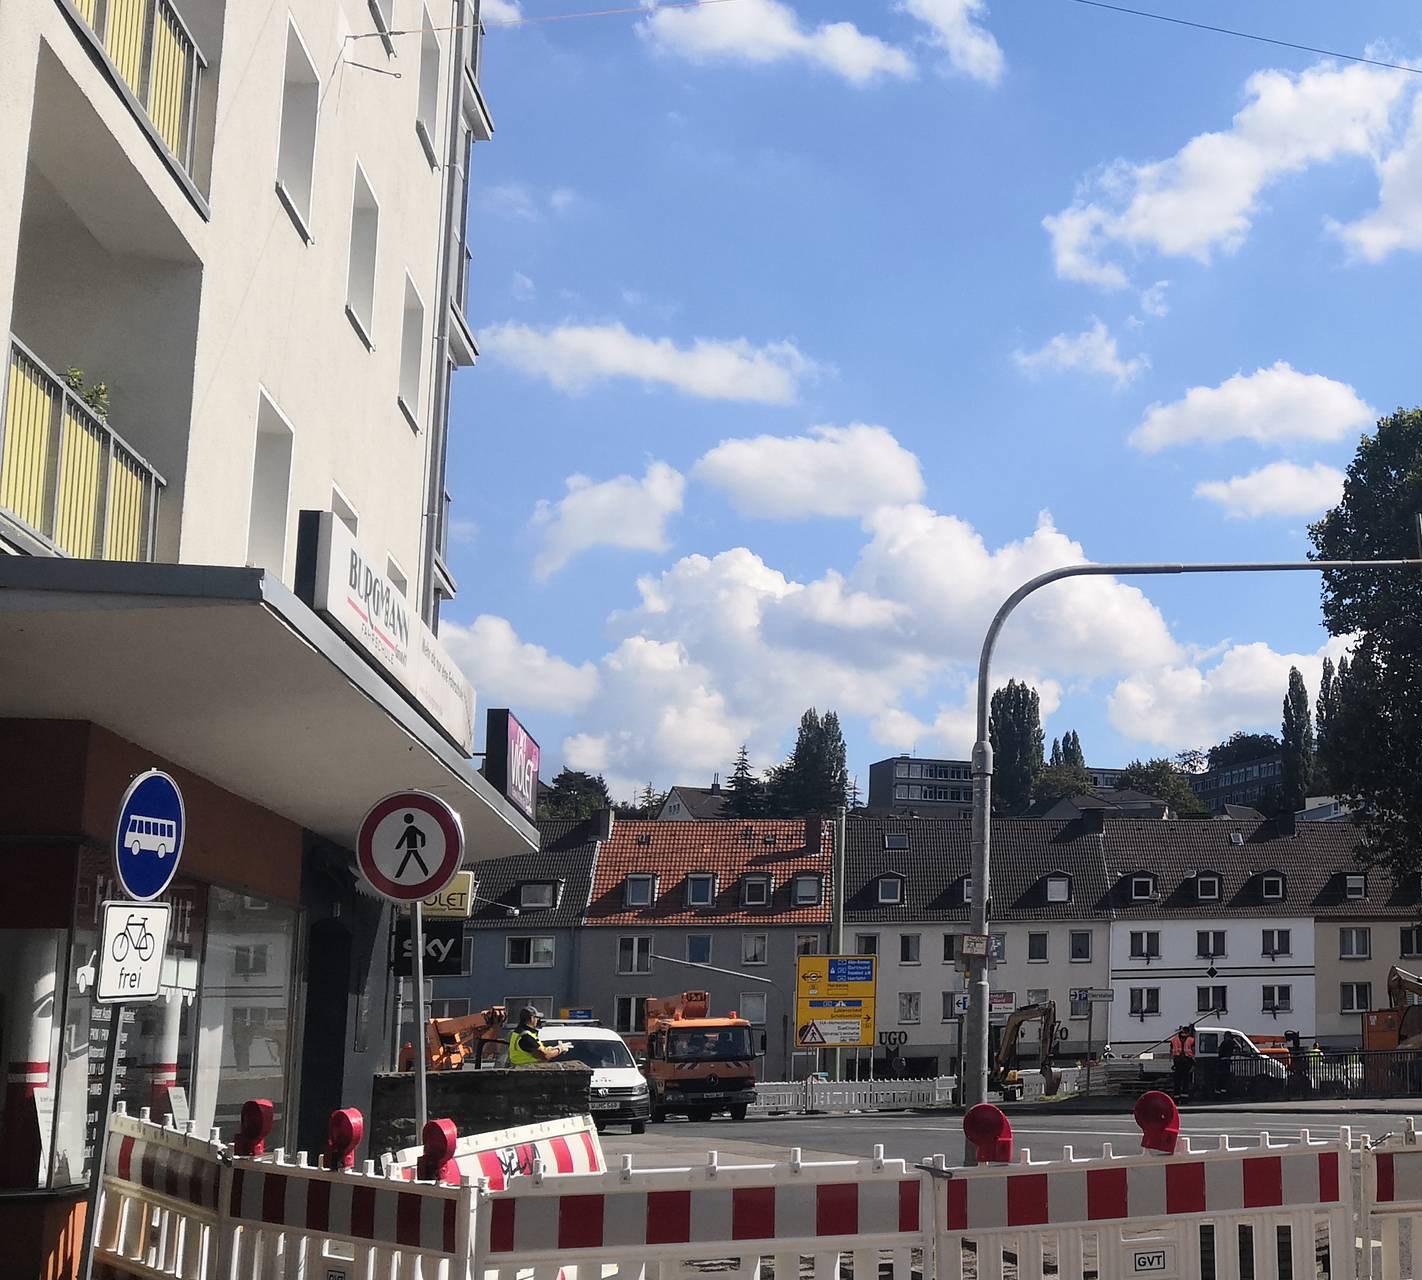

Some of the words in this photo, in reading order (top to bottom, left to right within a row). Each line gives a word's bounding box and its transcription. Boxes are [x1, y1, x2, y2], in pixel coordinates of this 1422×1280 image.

[349, 547, 409, 648] BURGMANN
[422, 892, 467, 907] OLET
[402, 932, 455, 962] sky
[118, 966, 142, 990] frei
[1137, 1255, 1163, 1267] GVT
